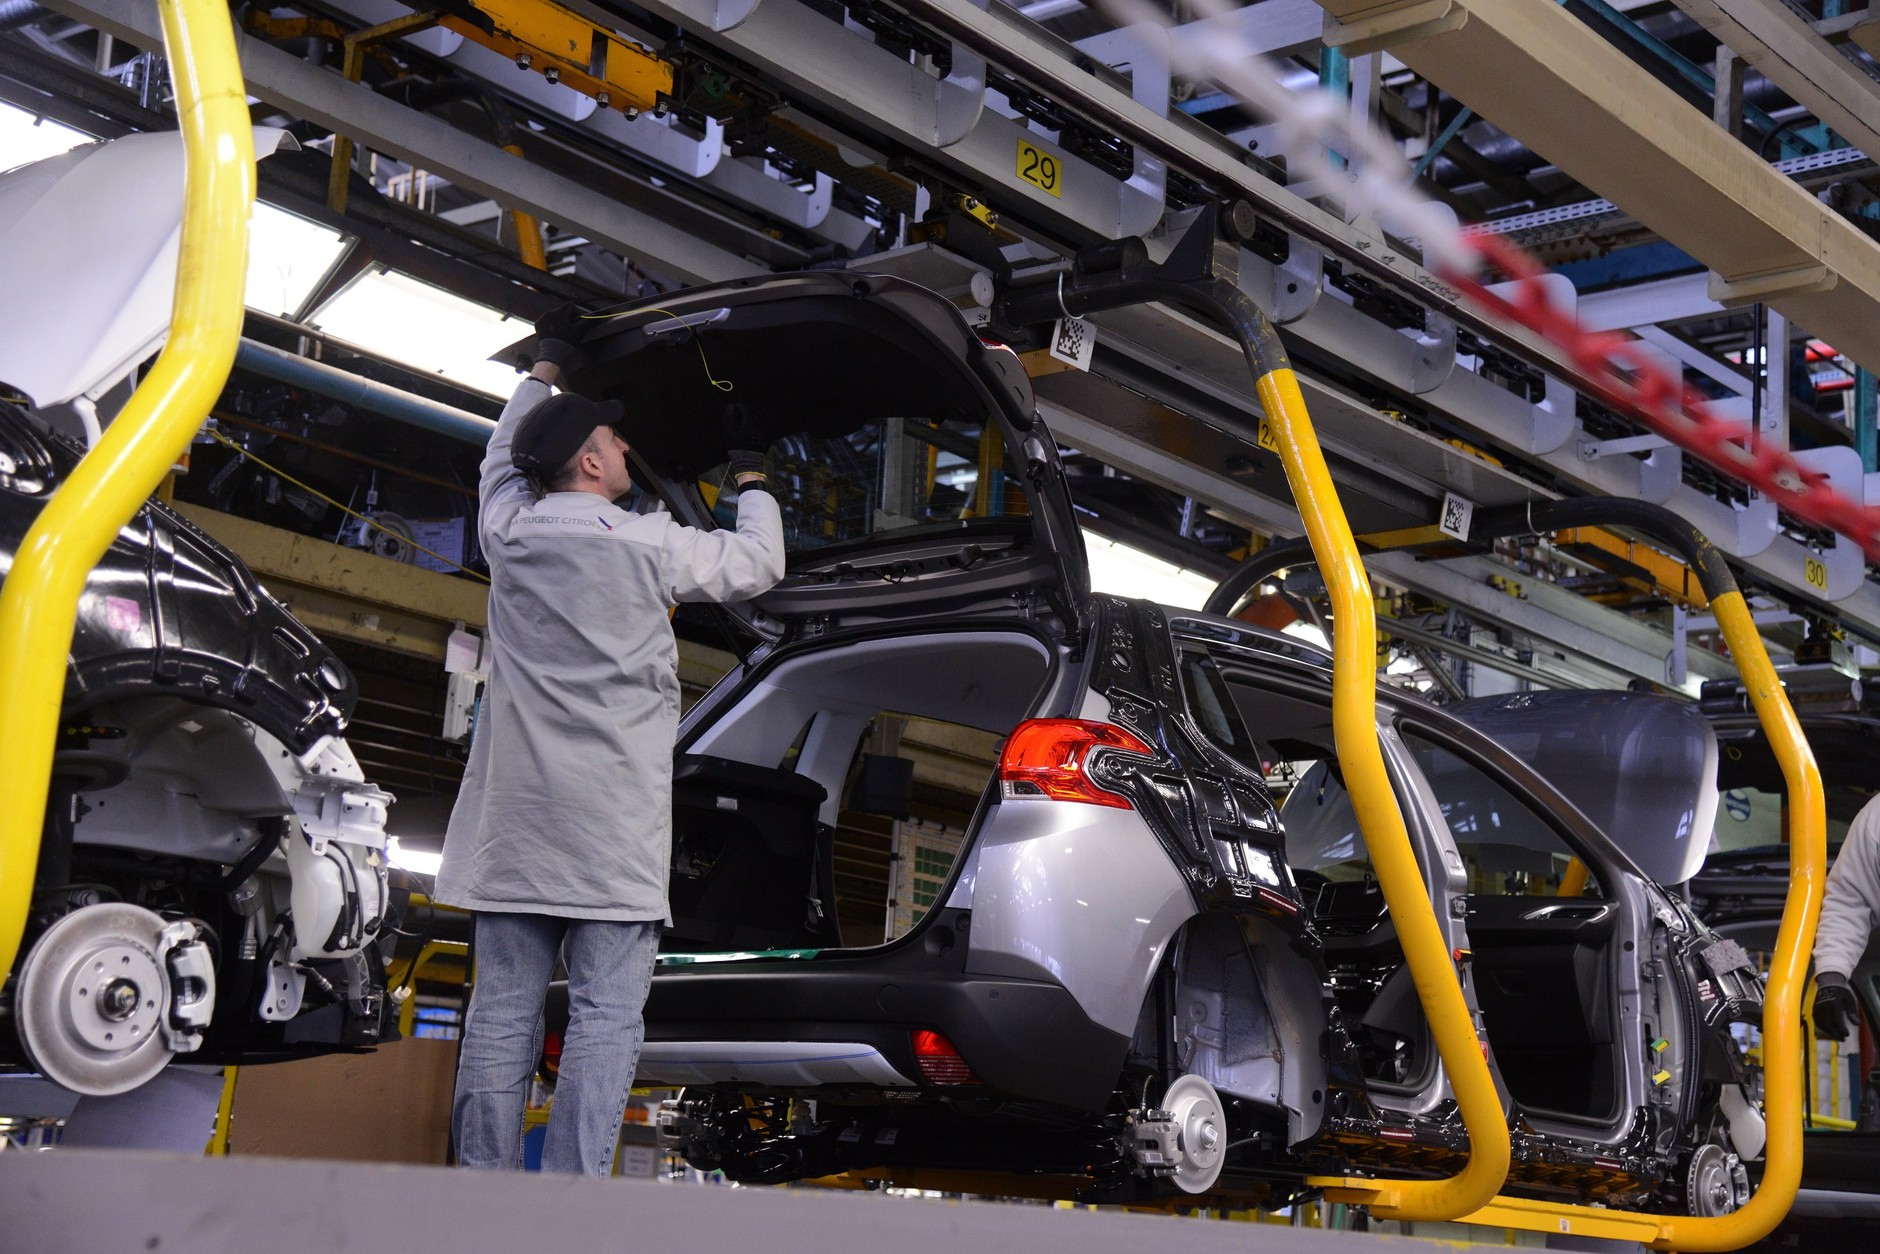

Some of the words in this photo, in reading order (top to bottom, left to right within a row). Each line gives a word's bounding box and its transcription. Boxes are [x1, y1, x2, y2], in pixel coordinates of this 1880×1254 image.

[1022, 147, 1056, 190] 29
[520, 515, 560, 525] PEUGEOT
[1807, 560, 1824, 587] 30
